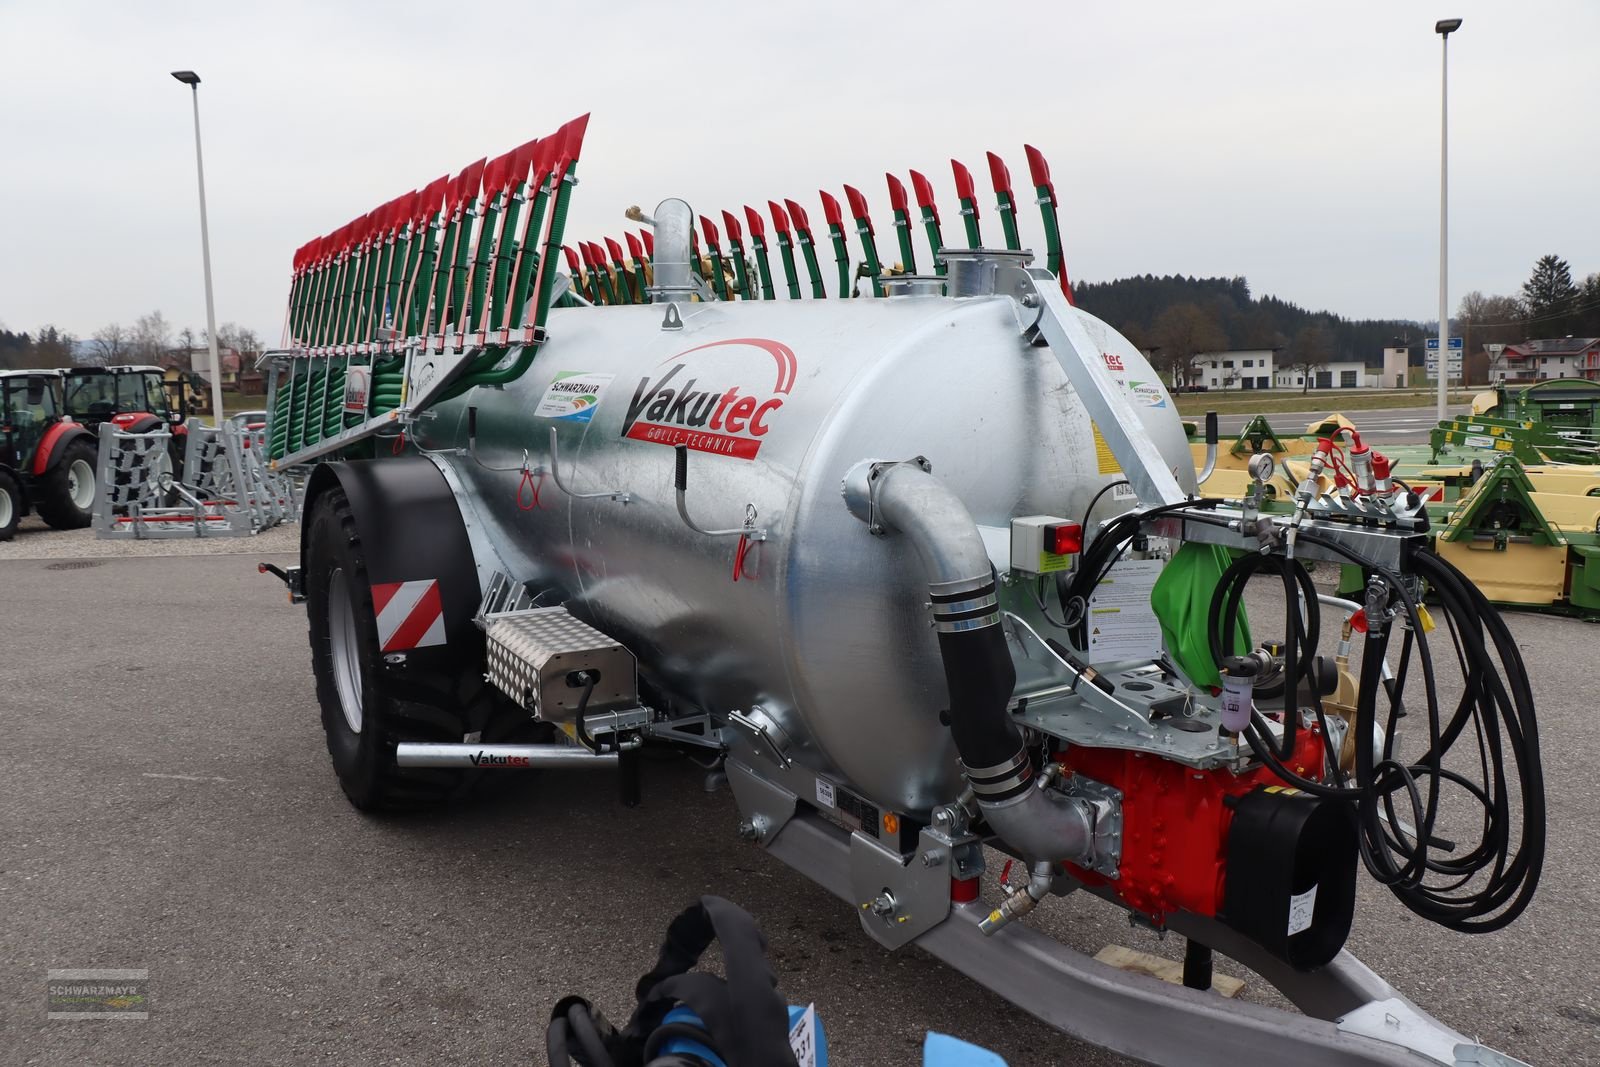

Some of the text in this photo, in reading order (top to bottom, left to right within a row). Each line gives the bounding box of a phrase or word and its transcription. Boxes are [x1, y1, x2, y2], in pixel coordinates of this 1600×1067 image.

[551, 382, 600, 395] SCHWARZMAYR
[621, 363, 784, 437] Vakutec
[469, 750, 529, 767] Vakutec
